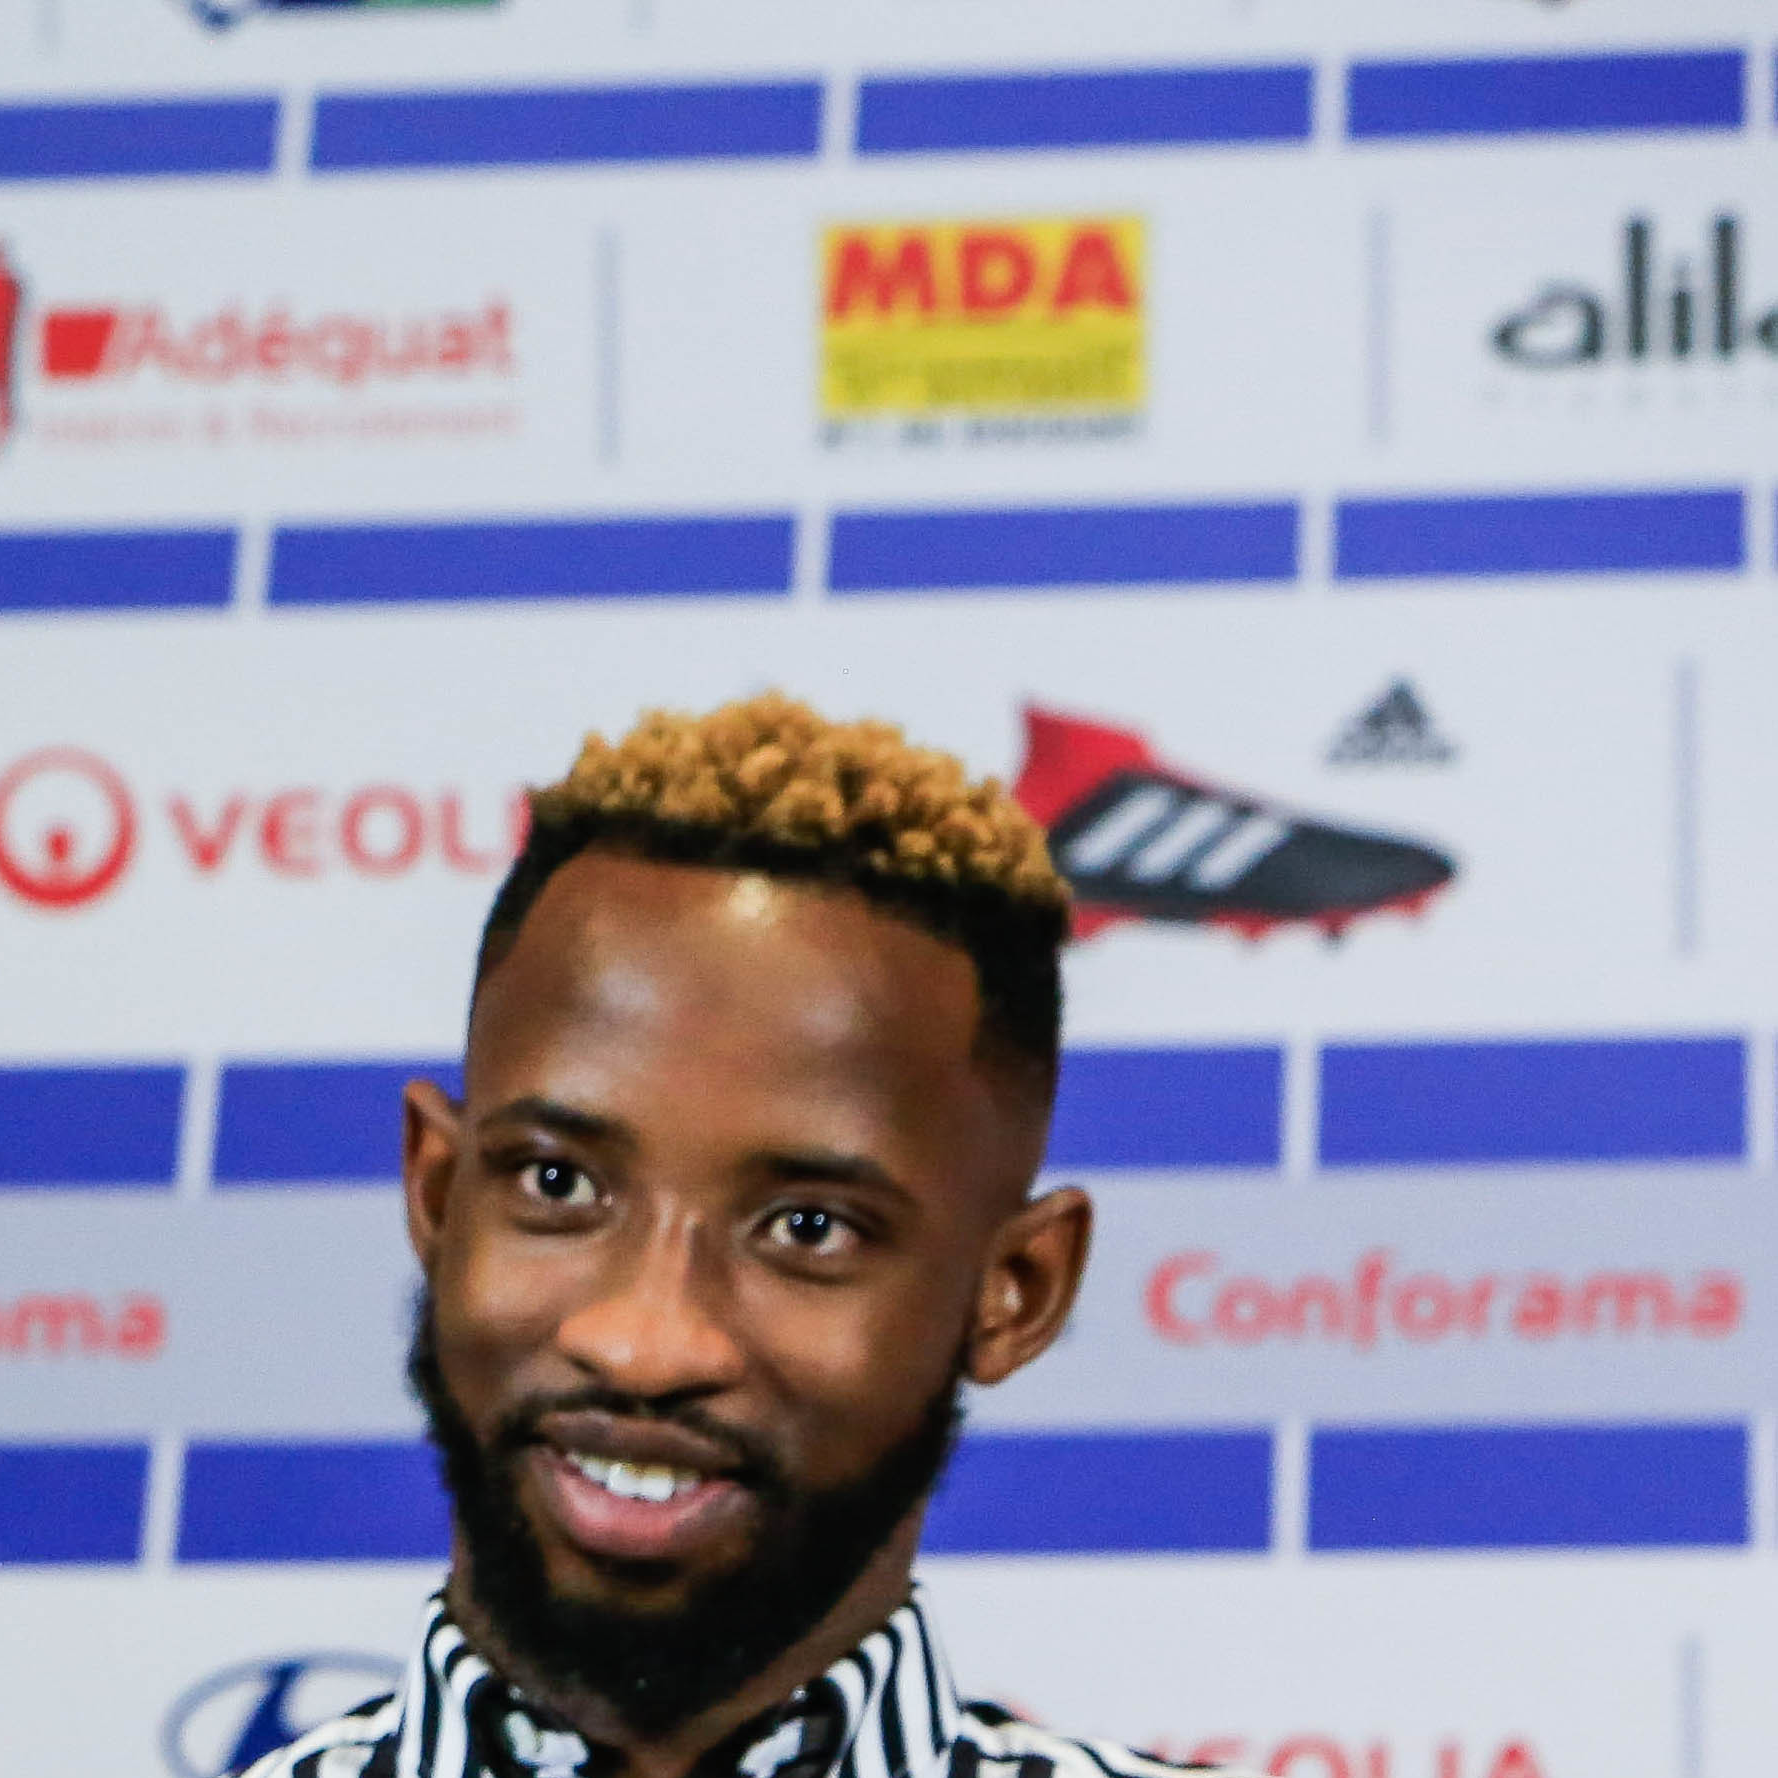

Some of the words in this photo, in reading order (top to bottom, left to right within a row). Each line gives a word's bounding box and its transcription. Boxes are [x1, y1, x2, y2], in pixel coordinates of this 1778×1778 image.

[829, 228, 1133, 318] MDA
[1487, 212, 1778, 368] alil
[168, 784, 532, 876] VEOLI
[1141, 1249, 1746, 1350] Conforama
